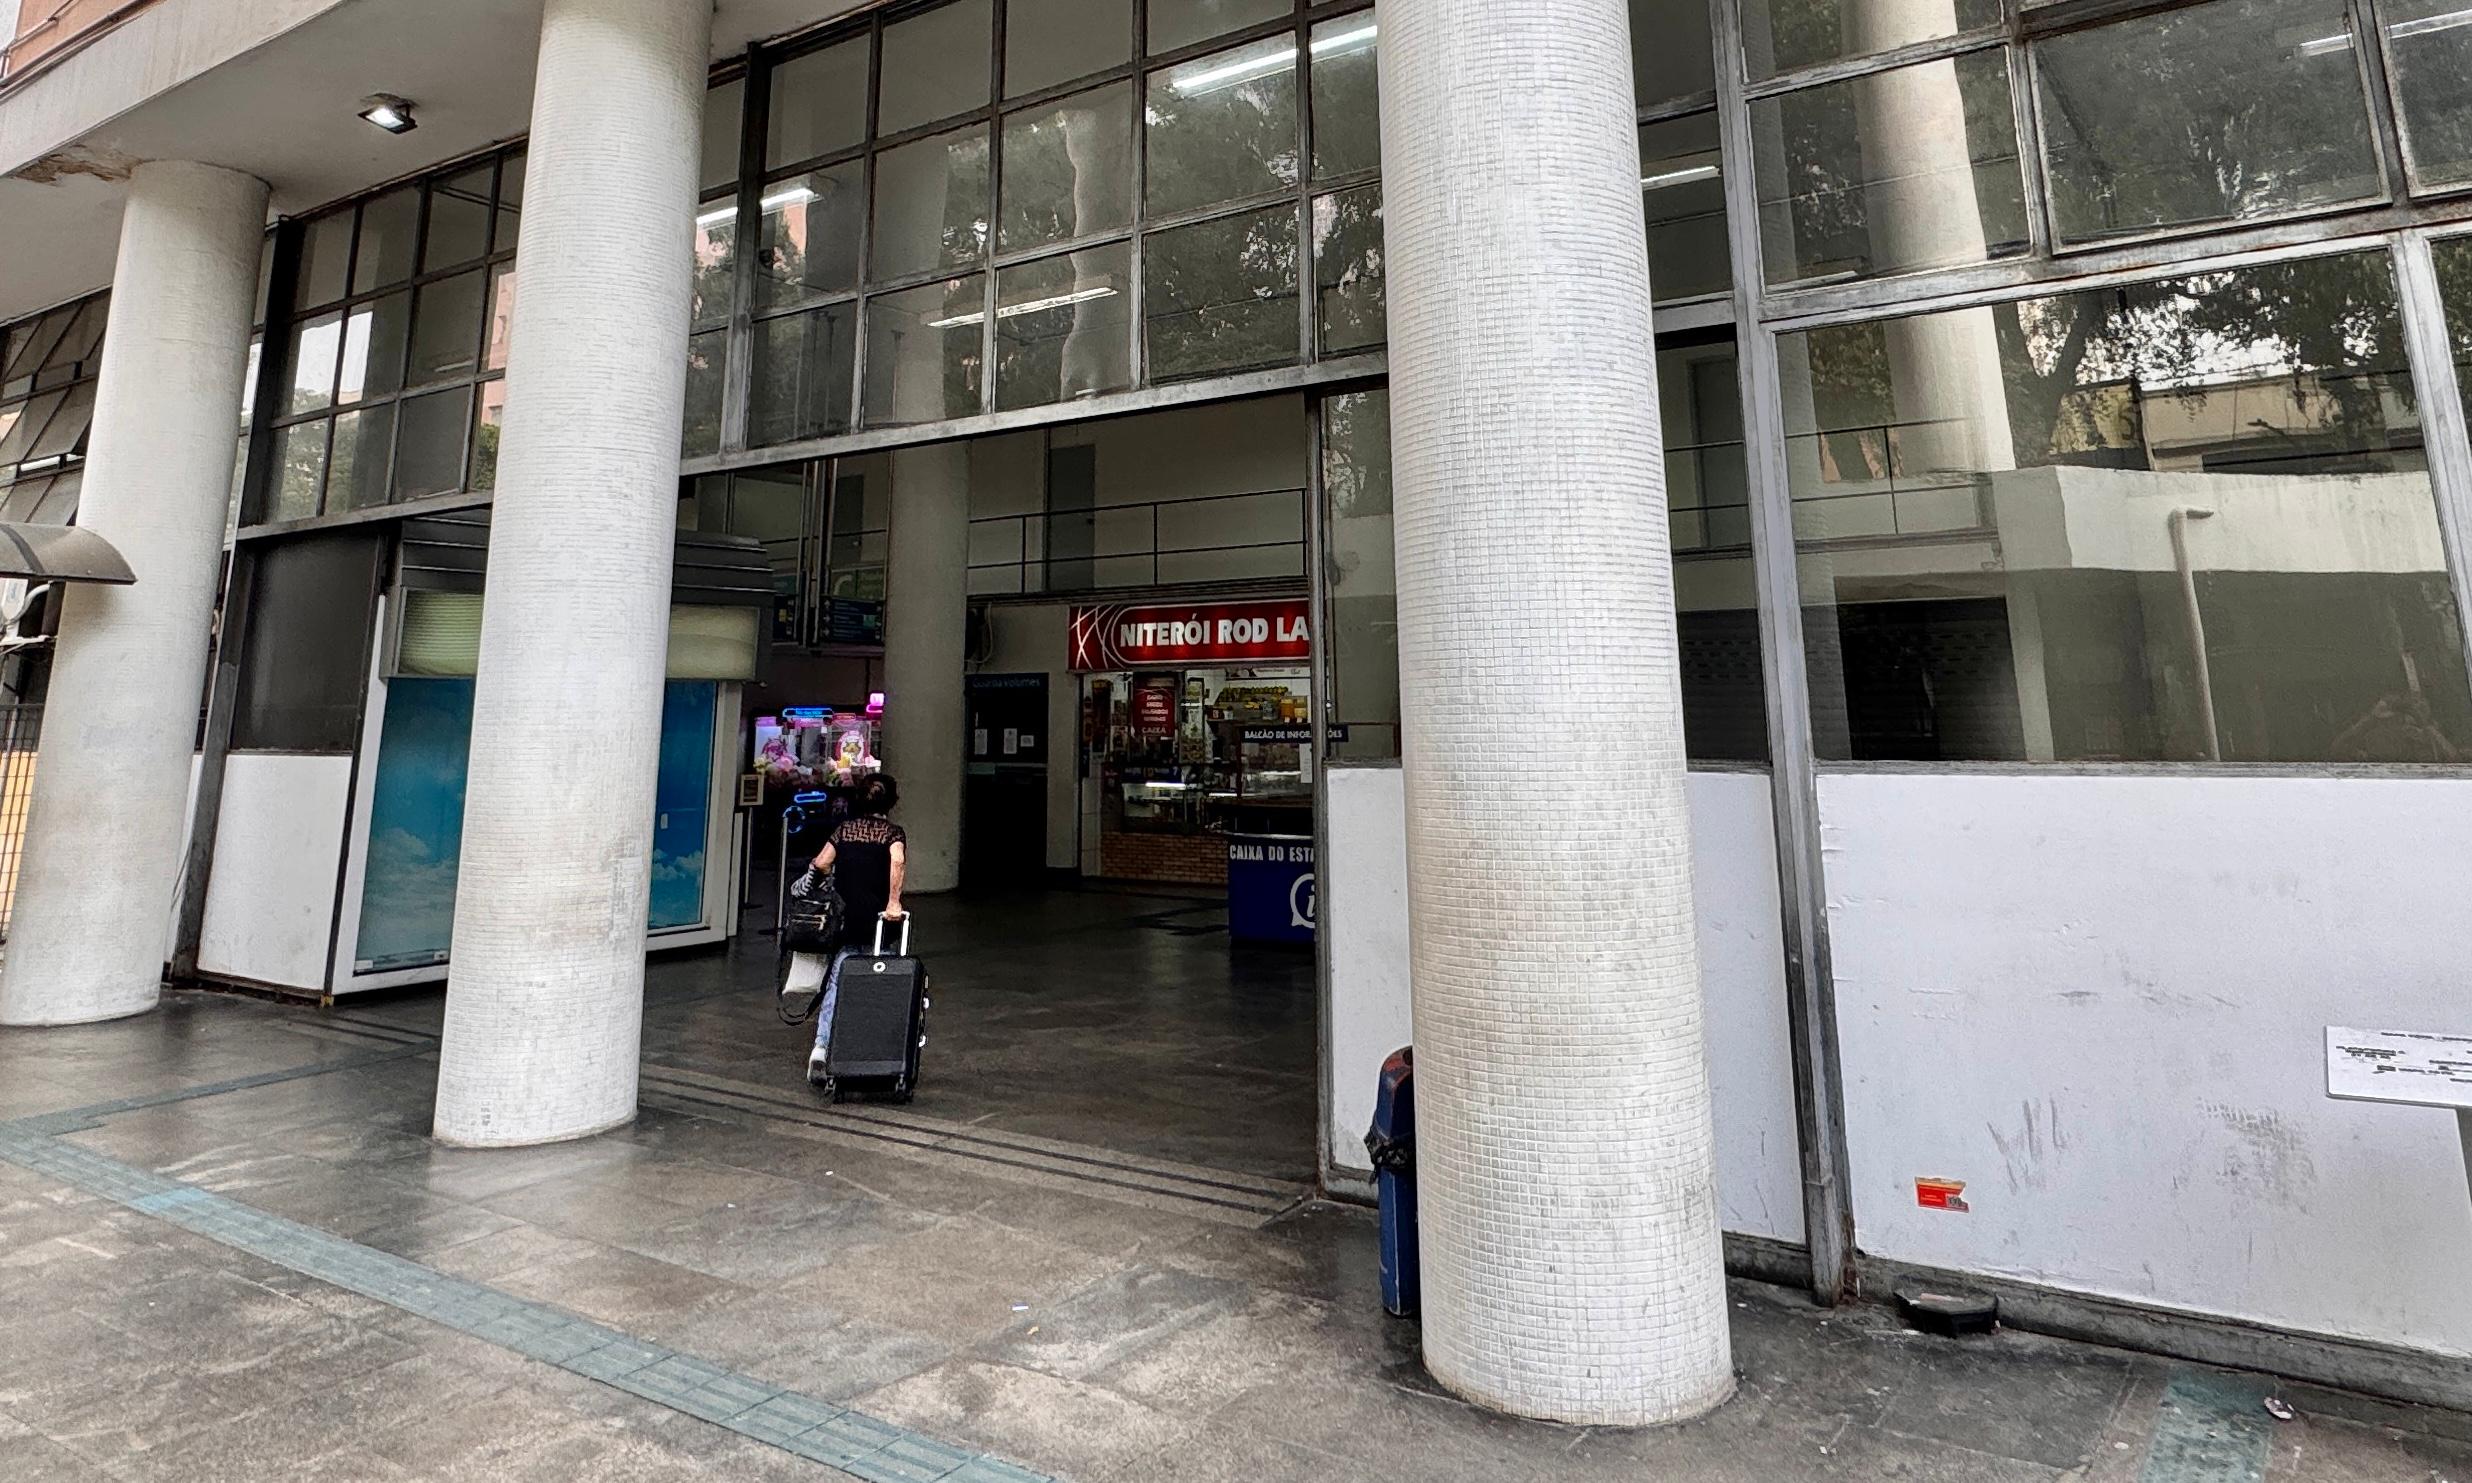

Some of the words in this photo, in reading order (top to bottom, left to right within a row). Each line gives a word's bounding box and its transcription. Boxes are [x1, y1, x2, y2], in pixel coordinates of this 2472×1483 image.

[1120, 613, 1211, 647] NITERÓI
[1217, 617, 1269, 645] ROD
[1276, 616, 1310, 643] LA
[1275, 730, 1286, 739] DE
[1229, 844, 1264, 861] CAIXA
[1268, 845, 1285, 862] DO
